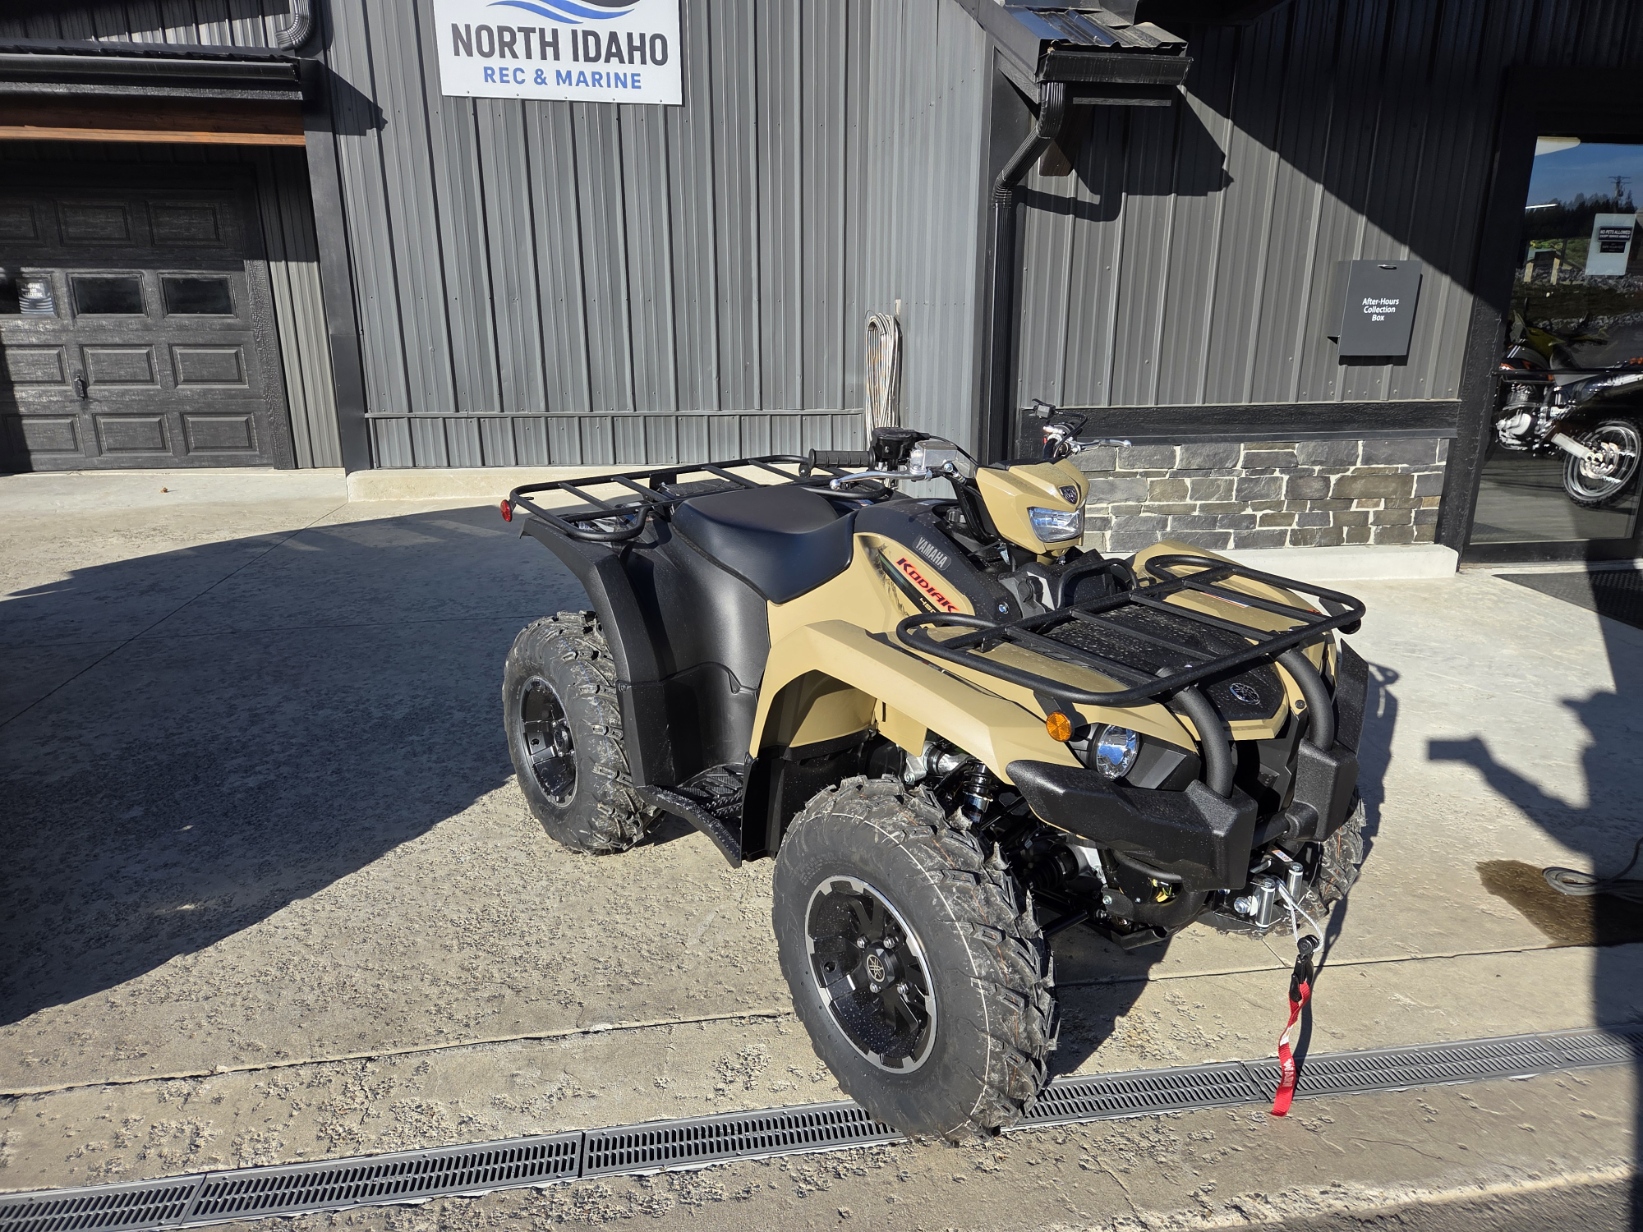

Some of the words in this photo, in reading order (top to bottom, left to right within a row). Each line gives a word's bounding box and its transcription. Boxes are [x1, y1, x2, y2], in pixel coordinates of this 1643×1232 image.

[451, 23, 560, 61] NORTH
[571, 29, 669, 66] IDAHO
[483, 66, 526, 85] REC
[533, 68, 548, 86] &
[556, 69, 642, 89] MARINE
[1362, 297, 1400, 305] After-Hours
[1363, 305, 1396, 313] Collection
[915, 536, 949, 568] YAMAHA
[896, 557, 960, 613] KODIAK
[1283, 1058, 1294, 1087] WARN
